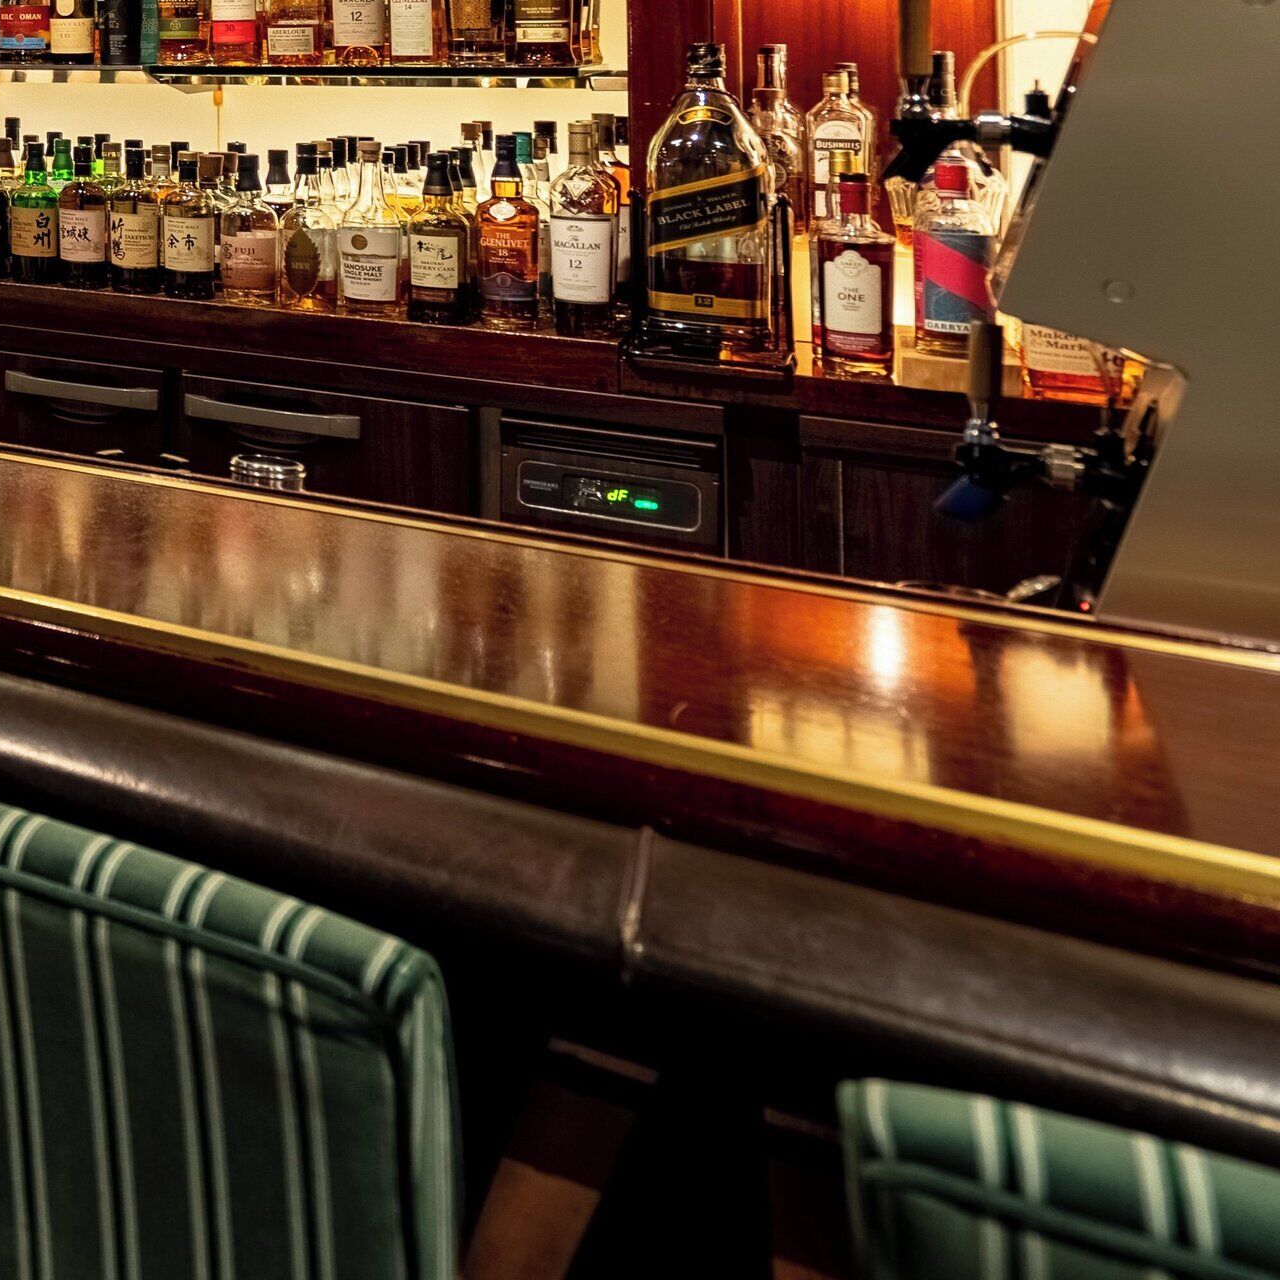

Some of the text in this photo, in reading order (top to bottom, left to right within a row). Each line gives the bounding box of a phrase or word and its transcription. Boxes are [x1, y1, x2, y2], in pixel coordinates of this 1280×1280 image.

[350, 11, 363, 22] 12
[224, 24, 235, 32] 30
[816, 140, 860, 150] BUSHMILLS
[657, 199, 750, 225] BLACK LABEL
[32, 211, 51, 249] 白州
[111, 217, 126, 261] 竹鶴
[167, 233, 197, 251] 余市
[480, 236, 529, 248] GLENLIVET
[554, 240, 602, 250] MACALLAN
[234, 247, 255, 255] FUJI
[568, 259, 582, 269] 12
[696, 297, 712, 305] 12
[837, 292, 866, 303] ONE
